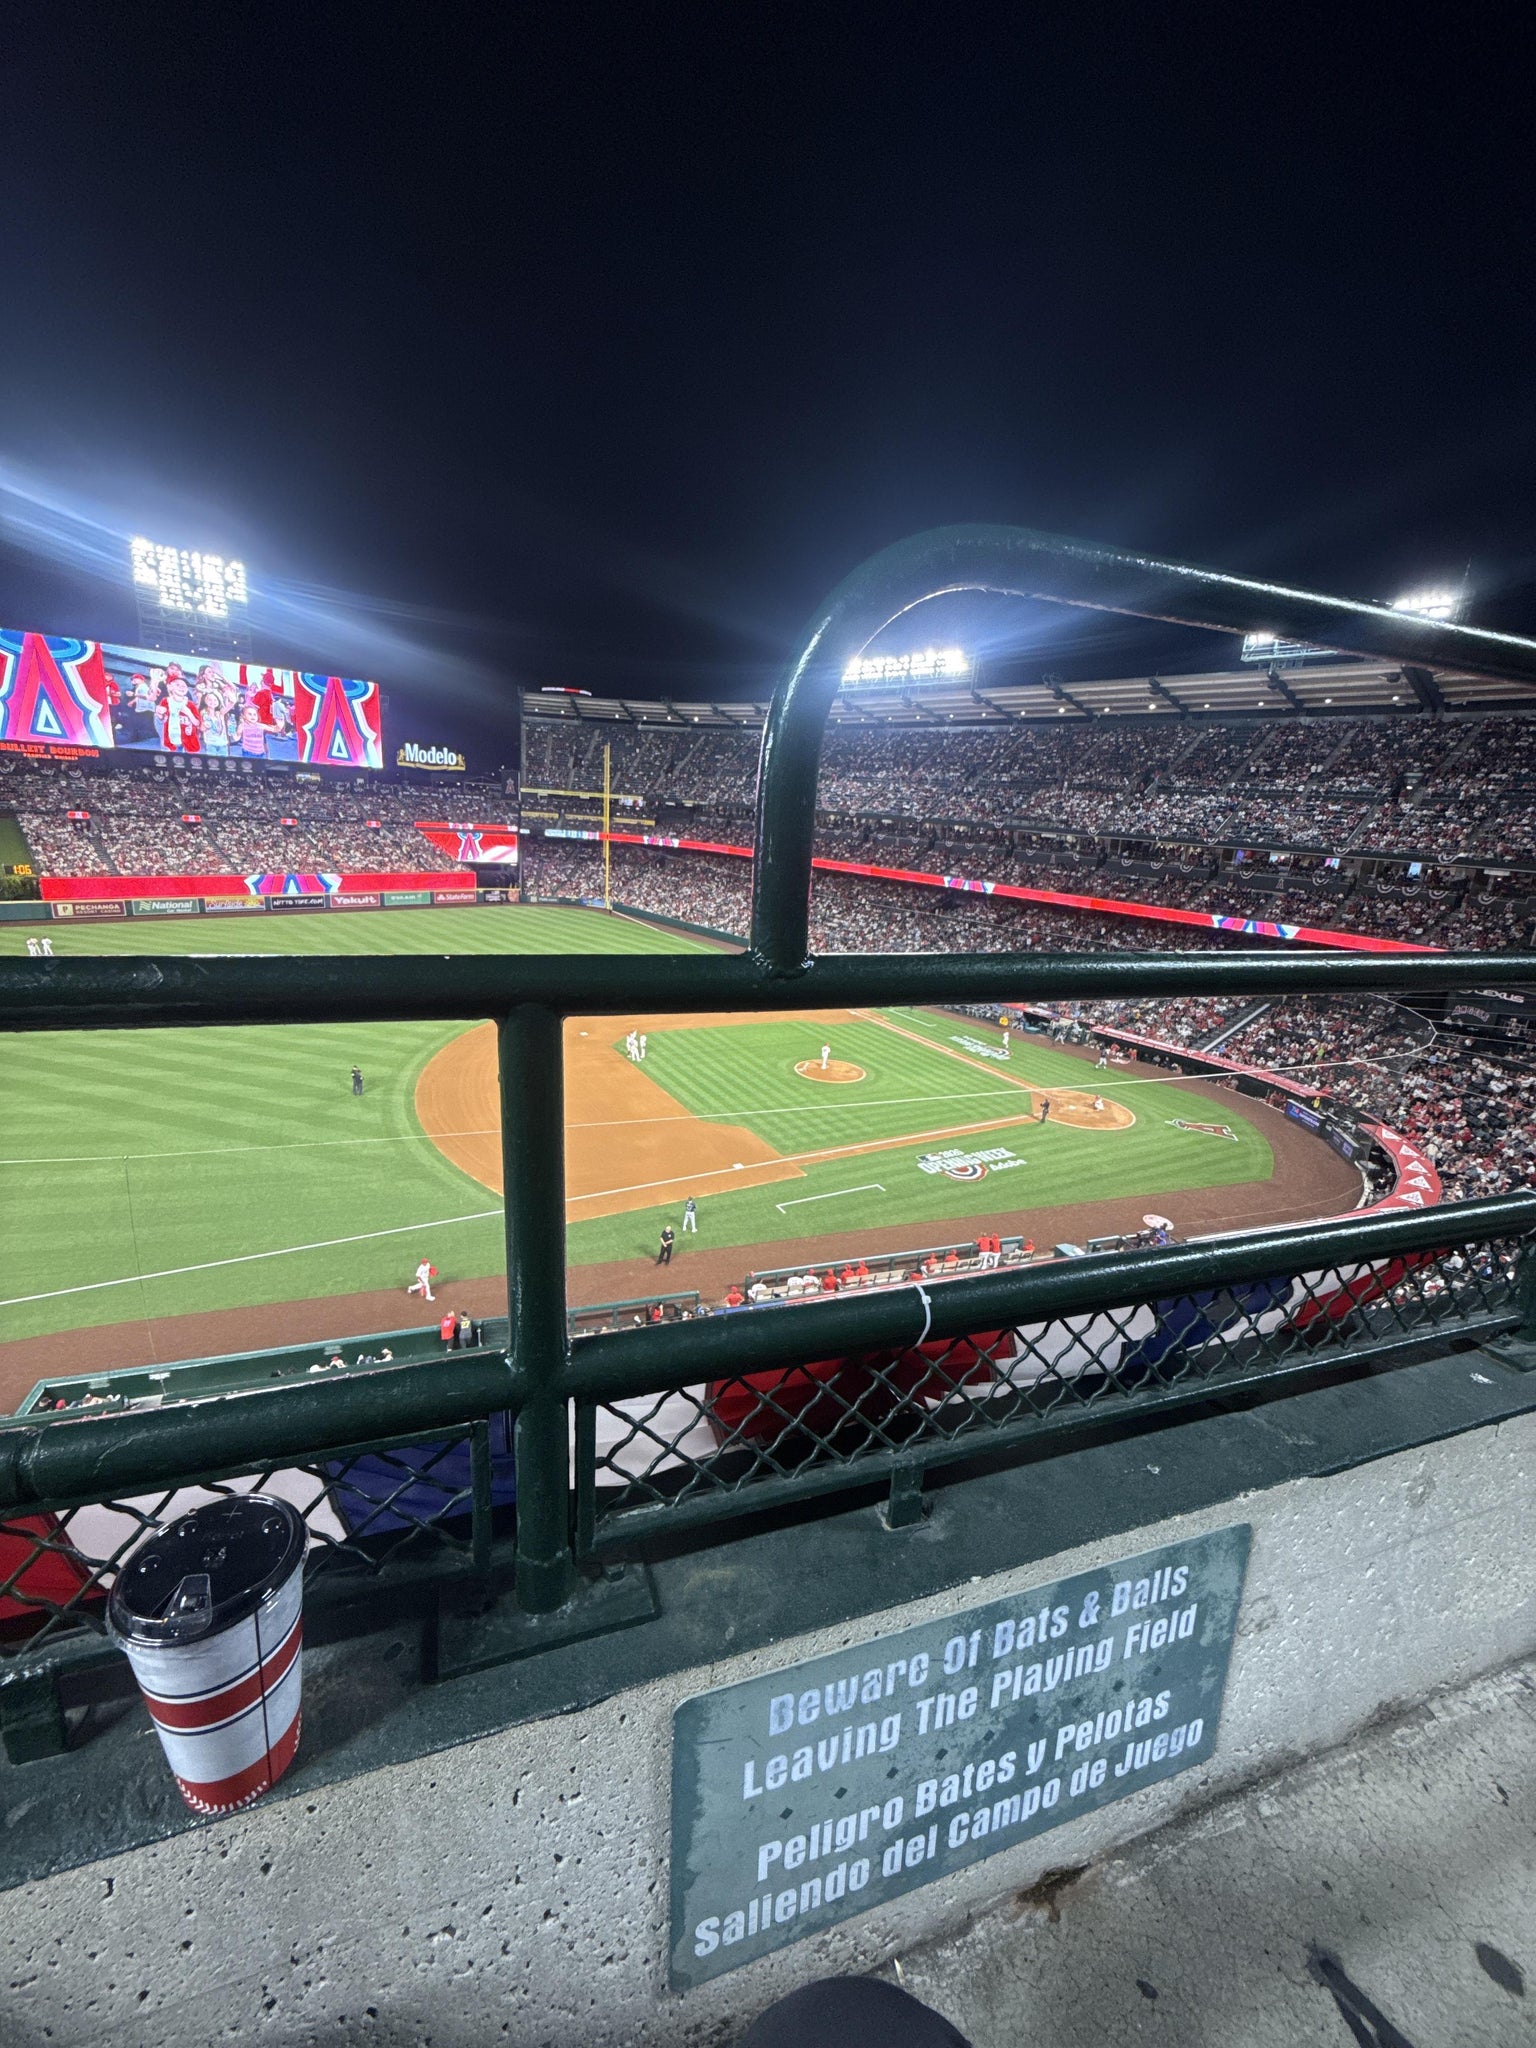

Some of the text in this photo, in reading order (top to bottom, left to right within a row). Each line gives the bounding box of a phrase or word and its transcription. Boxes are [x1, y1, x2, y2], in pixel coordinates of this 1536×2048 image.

[49, 745, 100, 758] BOURBON
[404, 742, 457, 766] Modelo
[151, 900, 193, 909] National
[334, 895, 377, 904] Yakult
[769, 1565, 1189, 1736] Beware Of Bats & Balls
[743, 1603, 1198, 1800] Leaving The Playing Field
[757, 1689, 1171, 1872] Peligro Bates y Pelotas
[694, 1717, 1204, 1957] Saliendo del Campo de Juego
